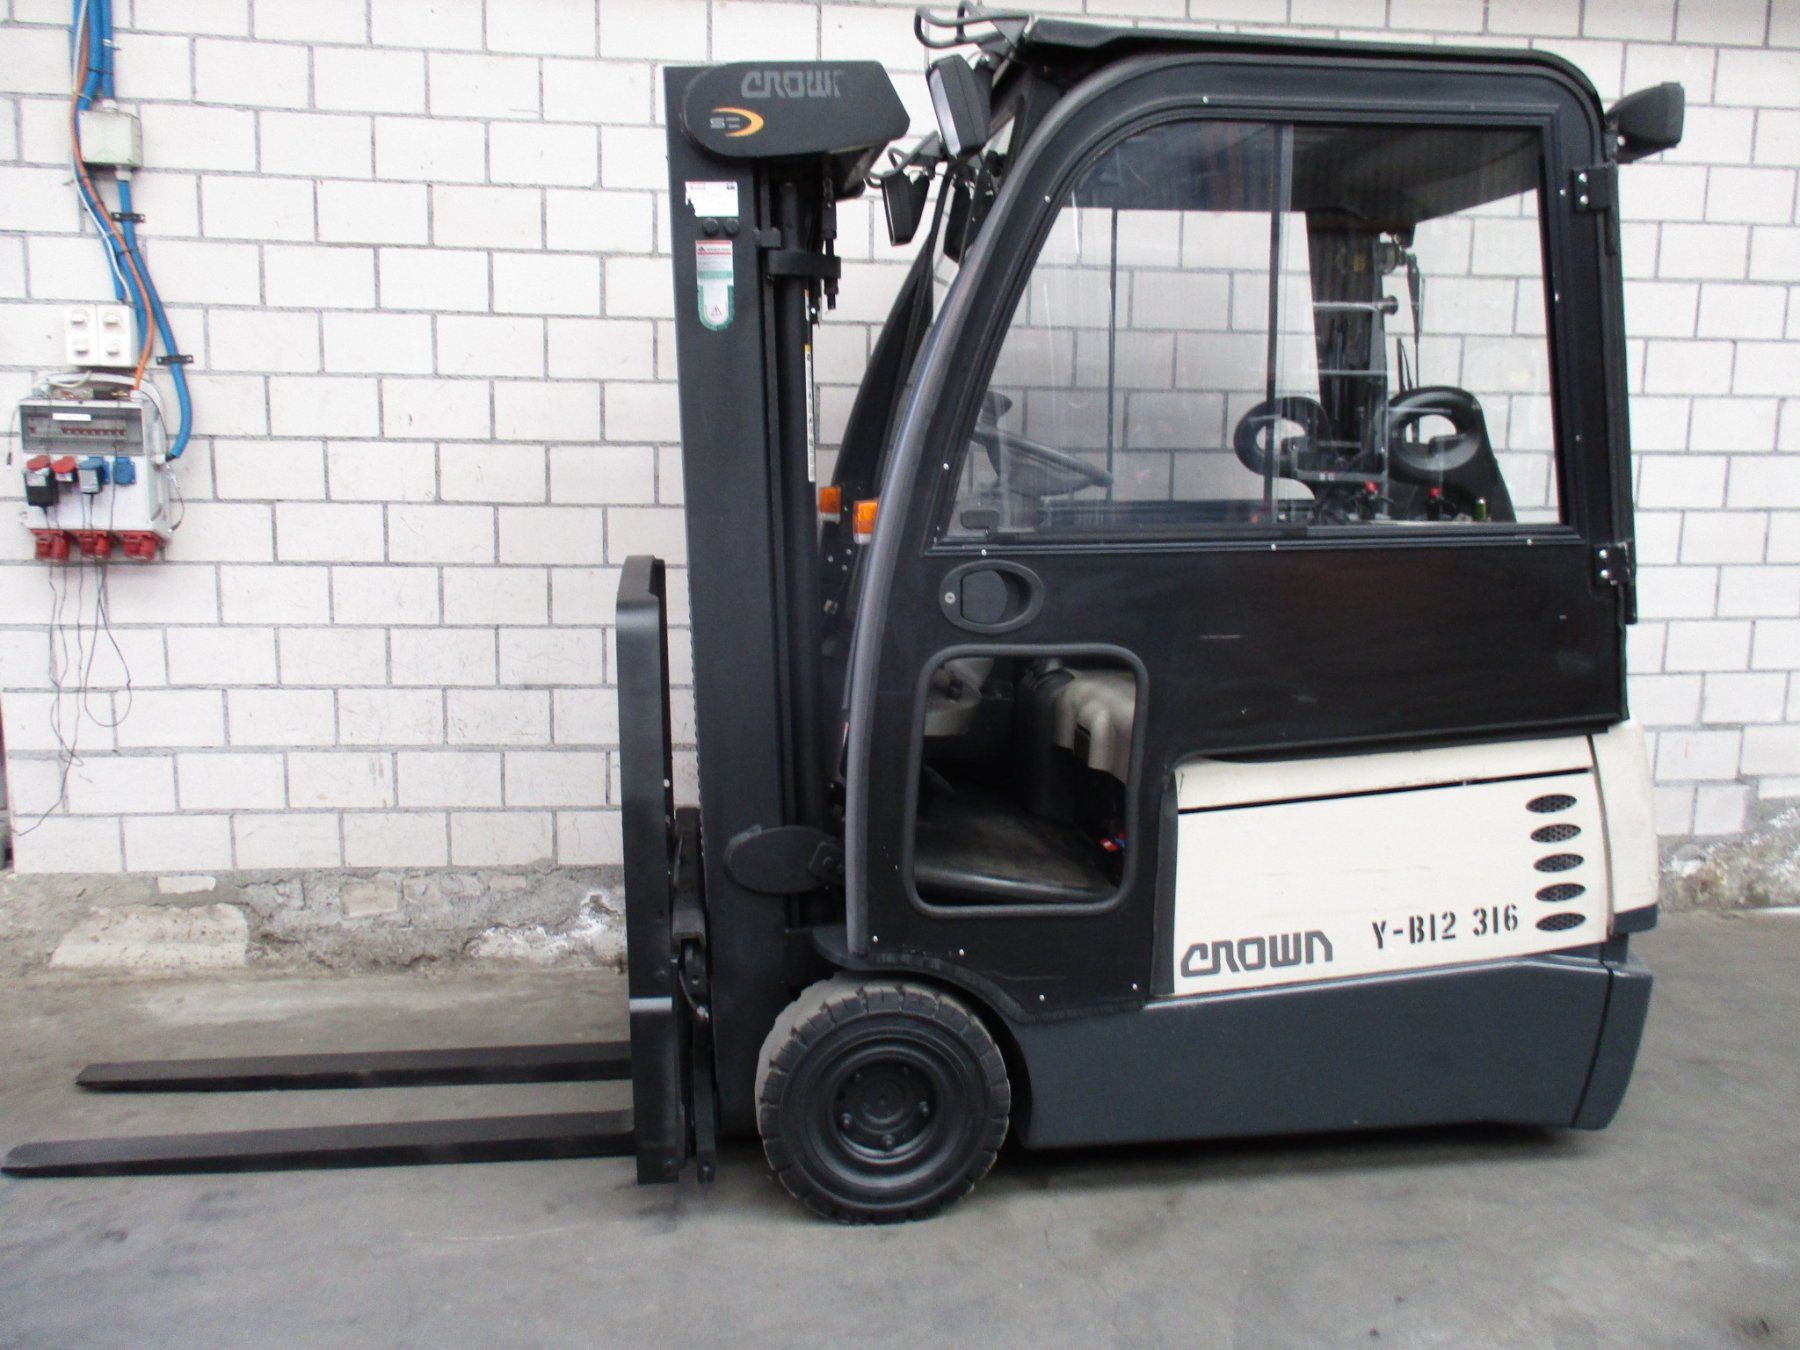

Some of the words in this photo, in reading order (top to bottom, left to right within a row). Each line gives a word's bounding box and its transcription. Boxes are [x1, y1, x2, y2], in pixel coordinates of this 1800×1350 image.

[1372, 911, 1457, 950] Y-B12
[1472, 903, 1519, 937] 316
[1180, 930, 1333, 977] CROWN
